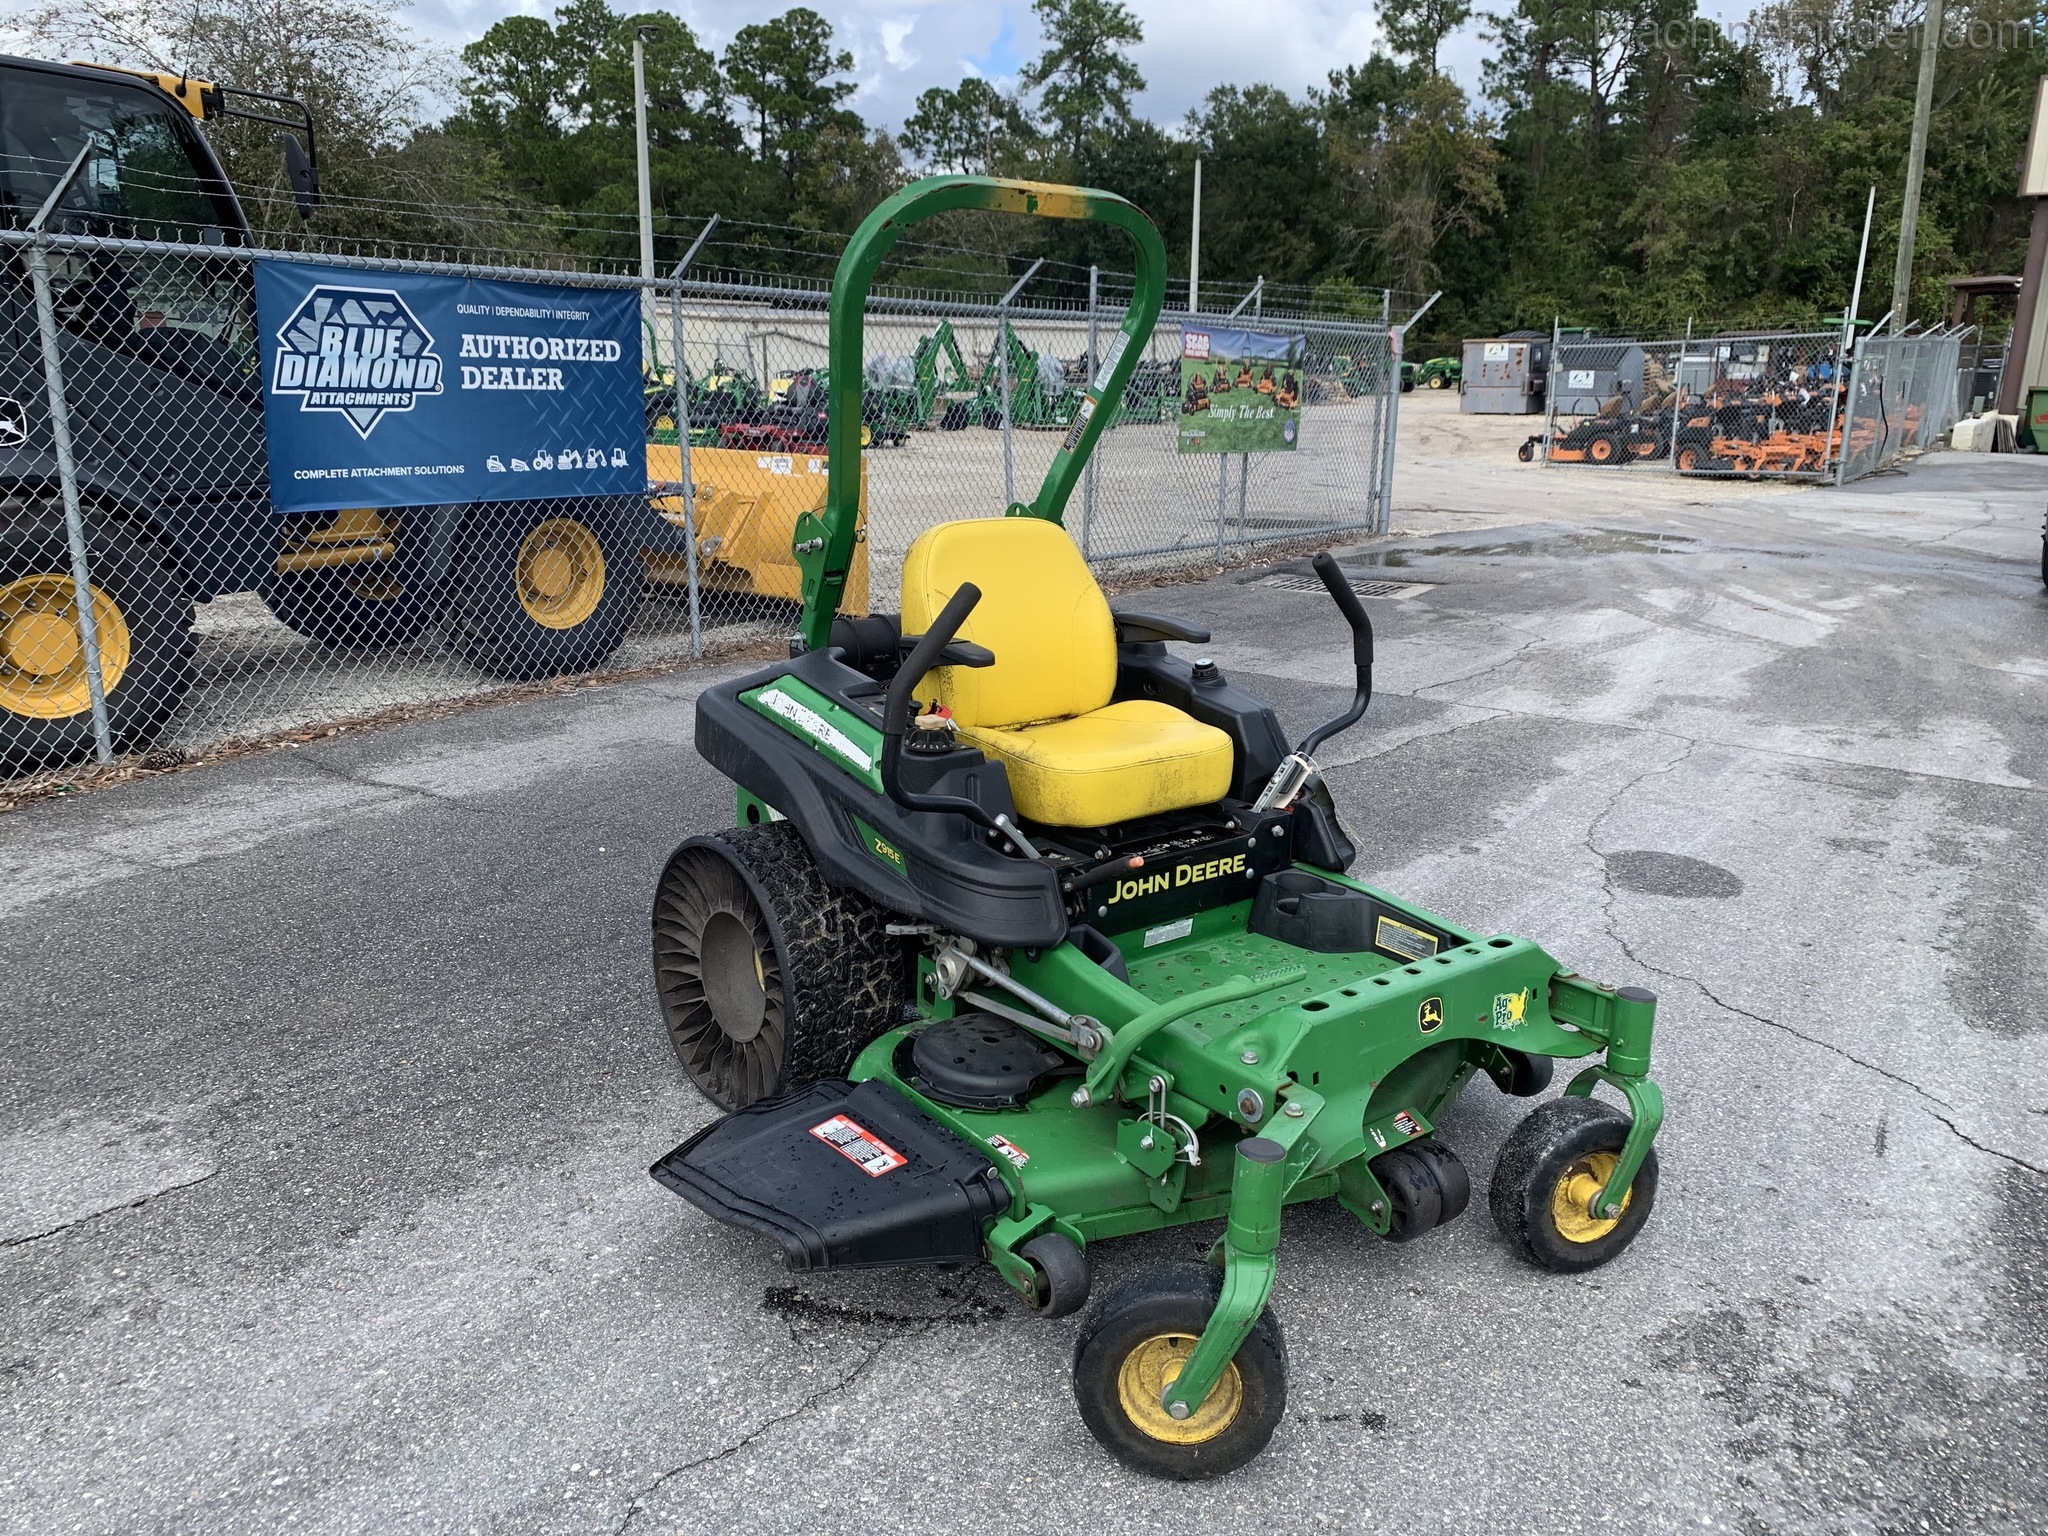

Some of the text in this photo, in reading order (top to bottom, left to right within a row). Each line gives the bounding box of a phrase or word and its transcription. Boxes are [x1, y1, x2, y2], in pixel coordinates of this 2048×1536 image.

[456, 304, 590, 321] QUALITY DEPENDABILITY INTEGRITY
[320, 325, 403, 359] BLUE
[459, 333, 621, 362] AUTHORIZED
[279, 353, 438, 389] DIAMOND
[460, 365, 565, 391] DEALER
[309, 391, 411, 406] ATTACHMENTS
[1207, 403, 1237, 422] Simply
[1239, 404, 1255, 419] The
[294, 464, 465, 480] COMPLETE ATTACHMENT SOLUTIONS
[874, 837, 901, 865] Z915E
[1108, 853, 1246, 905] JOHN DEERE
